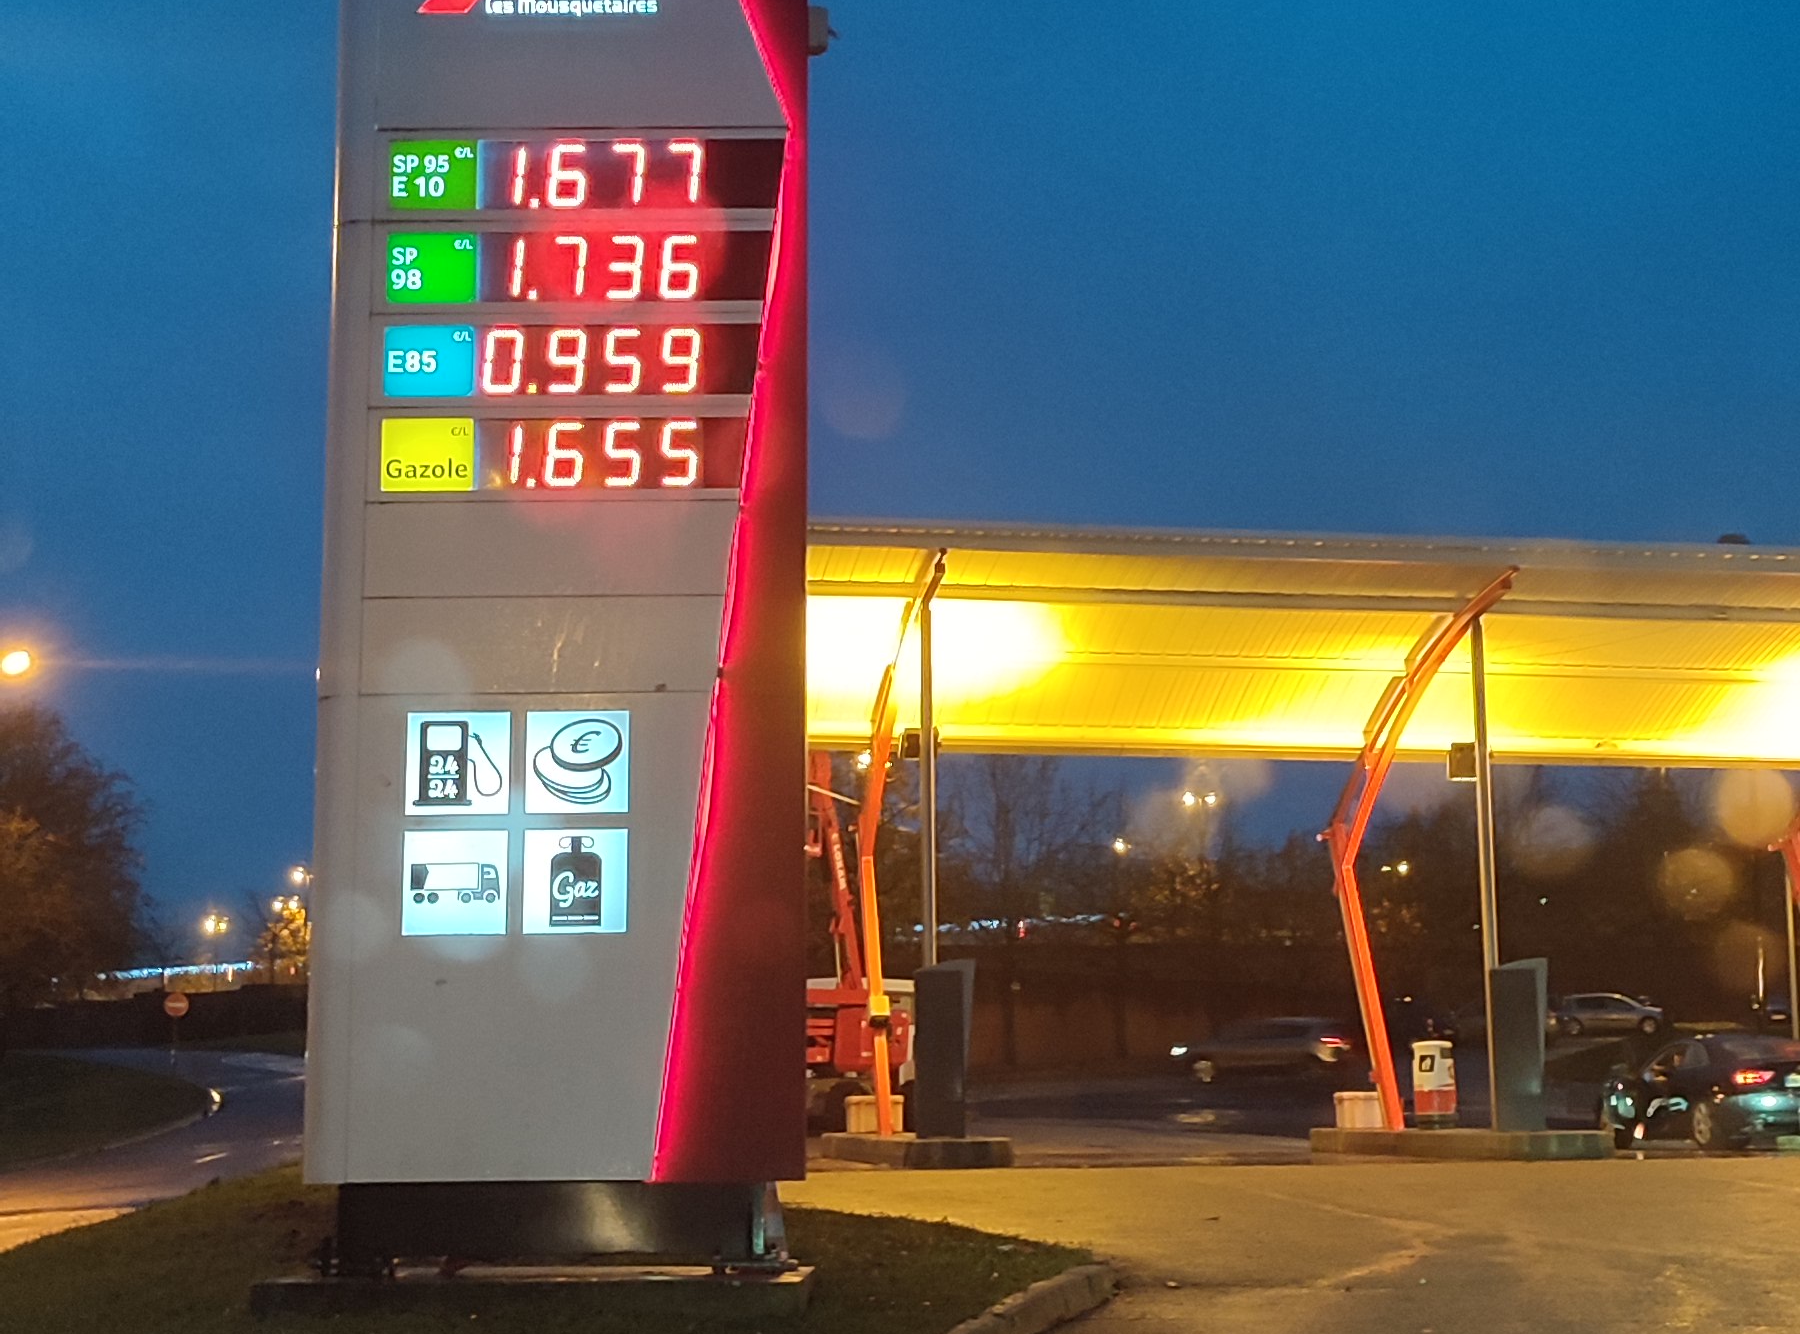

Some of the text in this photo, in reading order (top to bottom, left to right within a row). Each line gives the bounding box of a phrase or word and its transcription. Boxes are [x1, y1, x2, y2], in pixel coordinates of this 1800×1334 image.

[392, 154, 450, 174] SP 95
[512, 142, 702, 209] 1.677
[392, 175, 445, 198] E 10
[391, 246, 418, 266] SP
[511, 235, 698, 300] 1.736
[390, 268, 422, 291] 98
[387, 350, 437, 373] E85
[481, 327, 701, 395] 0.959
[509, 420, 698, 489] 1.655
[386, 457, 468, 479] Gazole
[429, 755, 460, 775] 24
[428, 778, 459, 799] 24
[552, 871, 599, 908] Gaz
